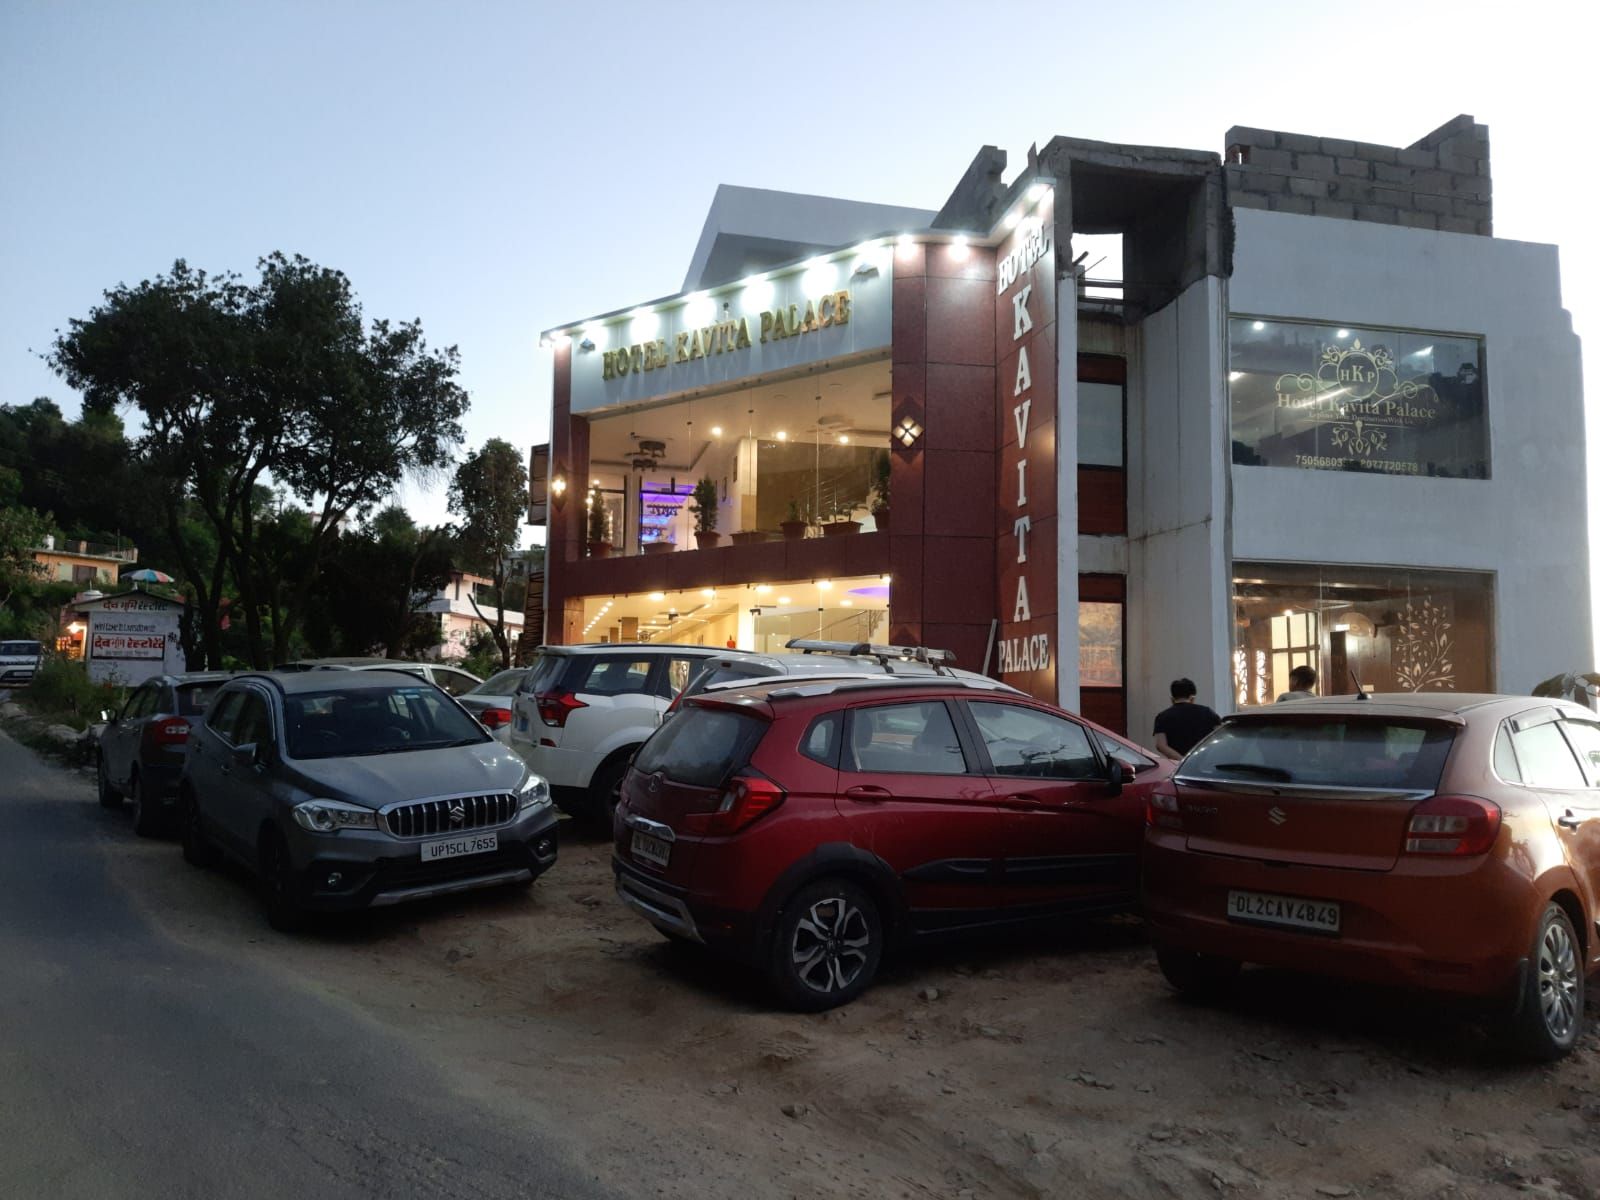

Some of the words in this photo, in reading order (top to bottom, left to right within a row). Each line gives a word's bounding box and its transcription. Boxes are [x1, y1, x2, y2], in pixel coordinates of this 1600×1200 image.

[997, 223, 1050, 296] HOTEL
[602, 338, 668, 380] HOTEL
[674, 317, 752, 364] KAVITA
[760, 290, 851, 343] PALACE
[1329, 398, 1380, 415] Kavita
[1385, 401, 1437, 419] Palace
[1012, 284, 1033, 622] KAVITA
[998, 633, 1050, 673] PALACE
